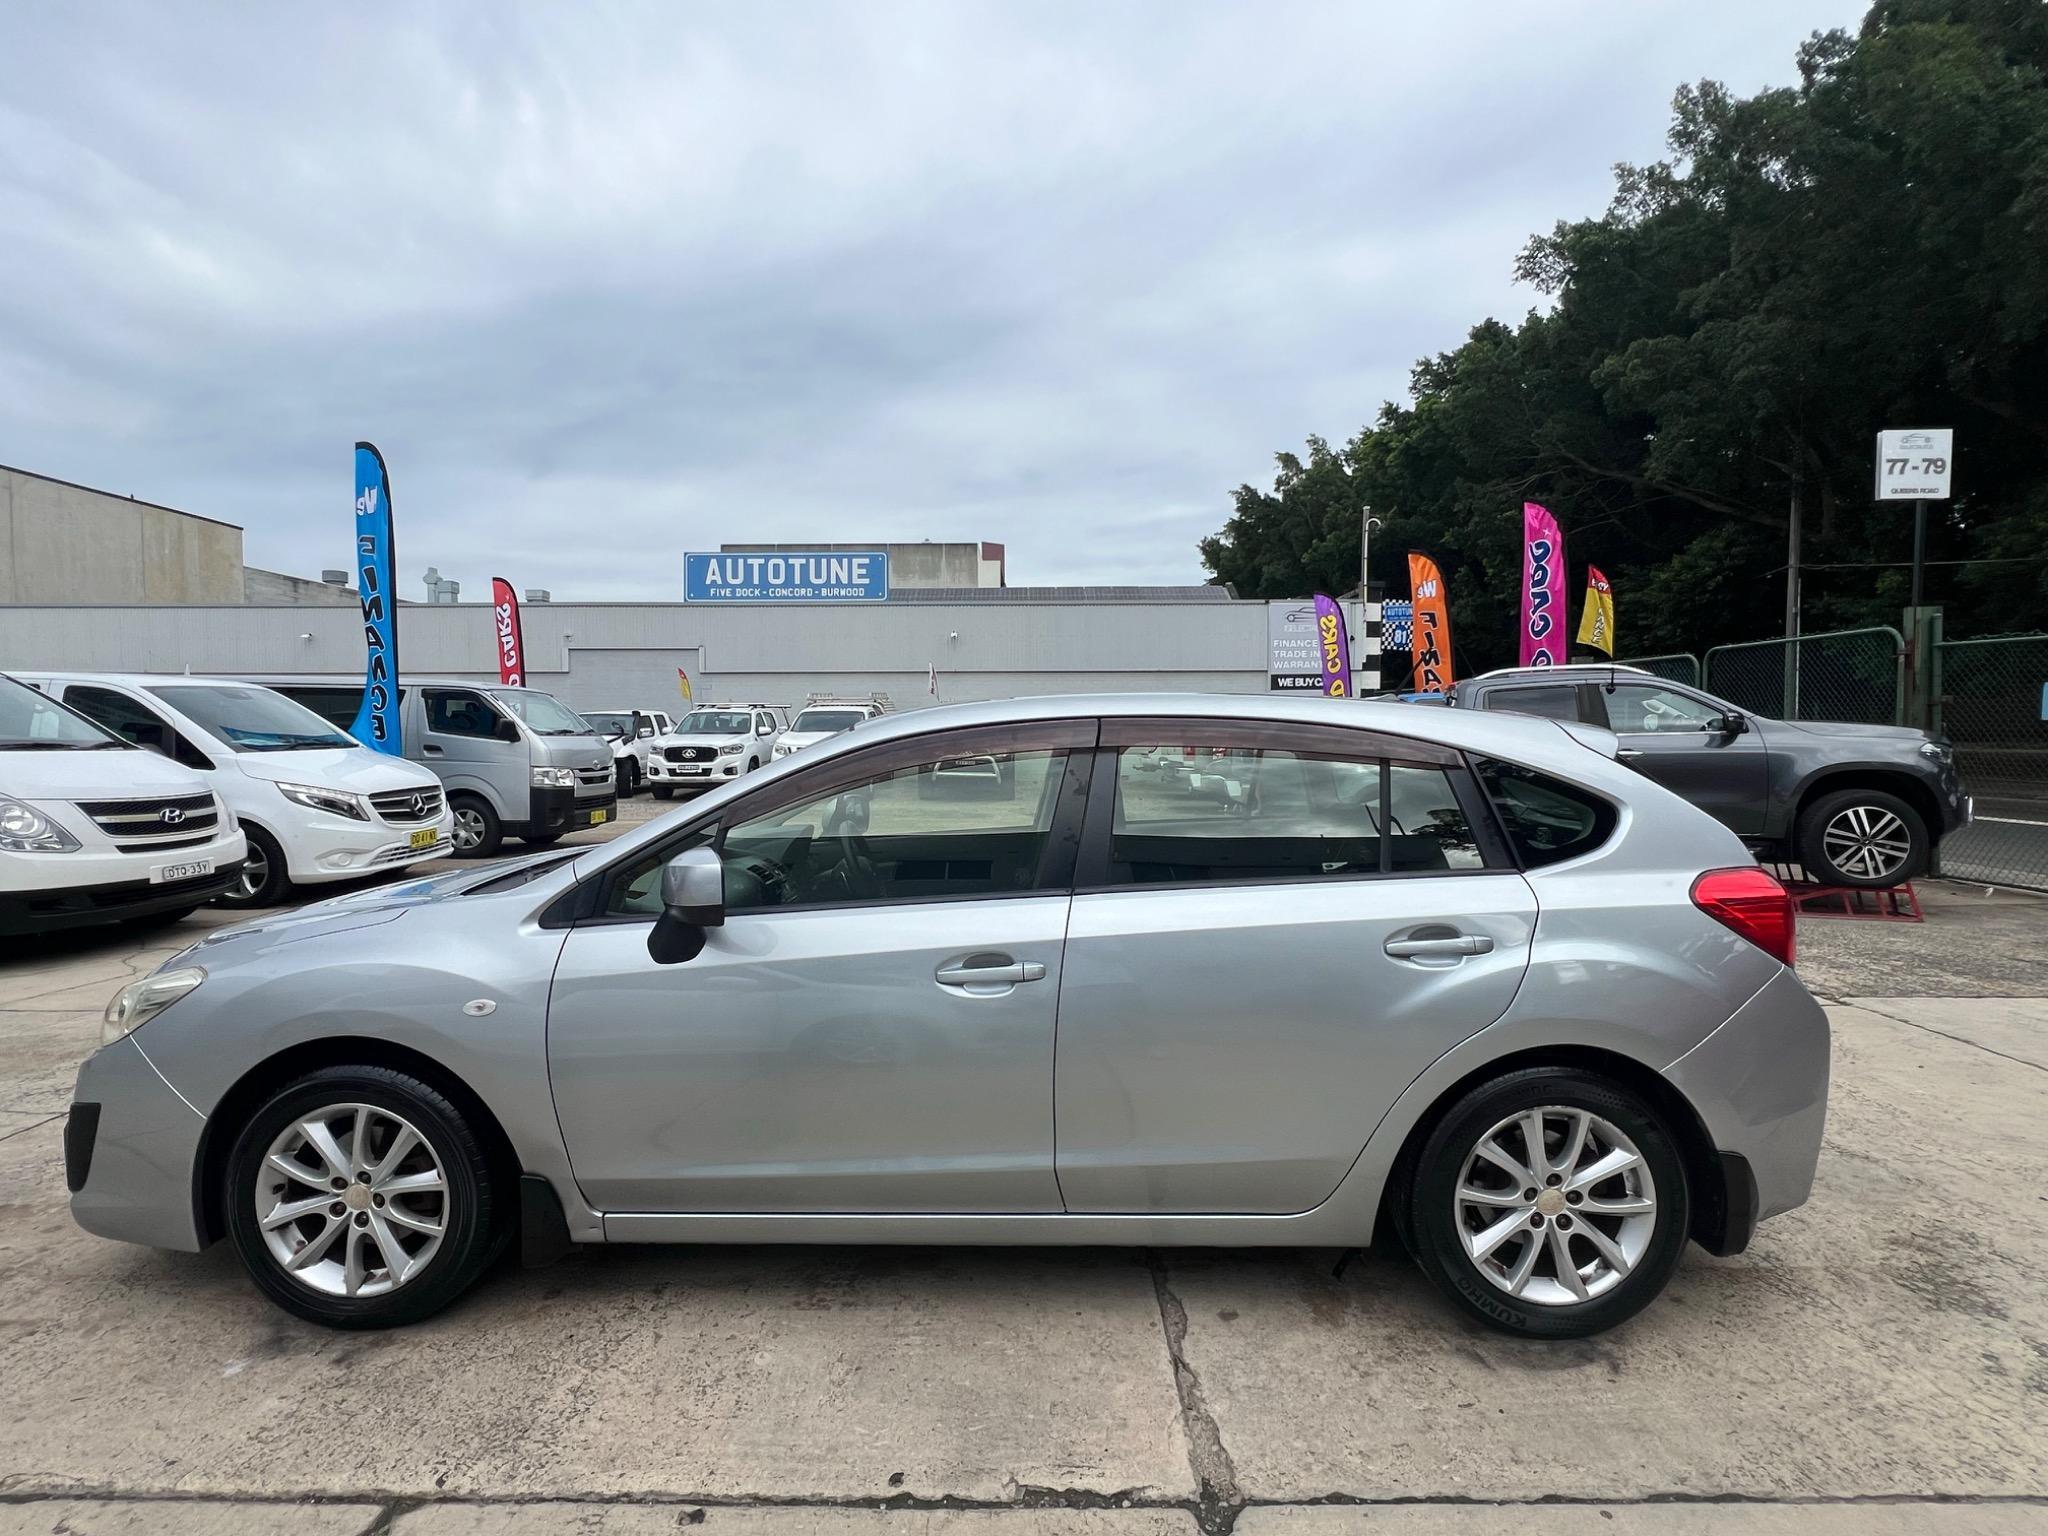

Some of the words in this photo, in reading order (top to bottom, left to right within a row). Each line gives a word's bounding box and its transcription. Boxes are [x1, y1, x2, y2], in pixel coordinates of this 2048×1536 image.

[1886, 458, 1910, 475] 77
[1922, 457, 1946, 475] 79
[705, 558, 870, 585] AUTOTUNE
[710, 587, 731, 597] FIVE
[736, 587, 761, 597] DOCK
[769, 587, 812, 597] CONCORD
[821, 587, 865, 597] BURWOOD
[1393, 630, 1407, 644] 81
[1273, 640, 1318, 648] FINANCE
[1273, 650, 1307, 658] TRADE
[1277, 677, 1294, 687] WE
[1295, 677, 1314, 687] BUY
